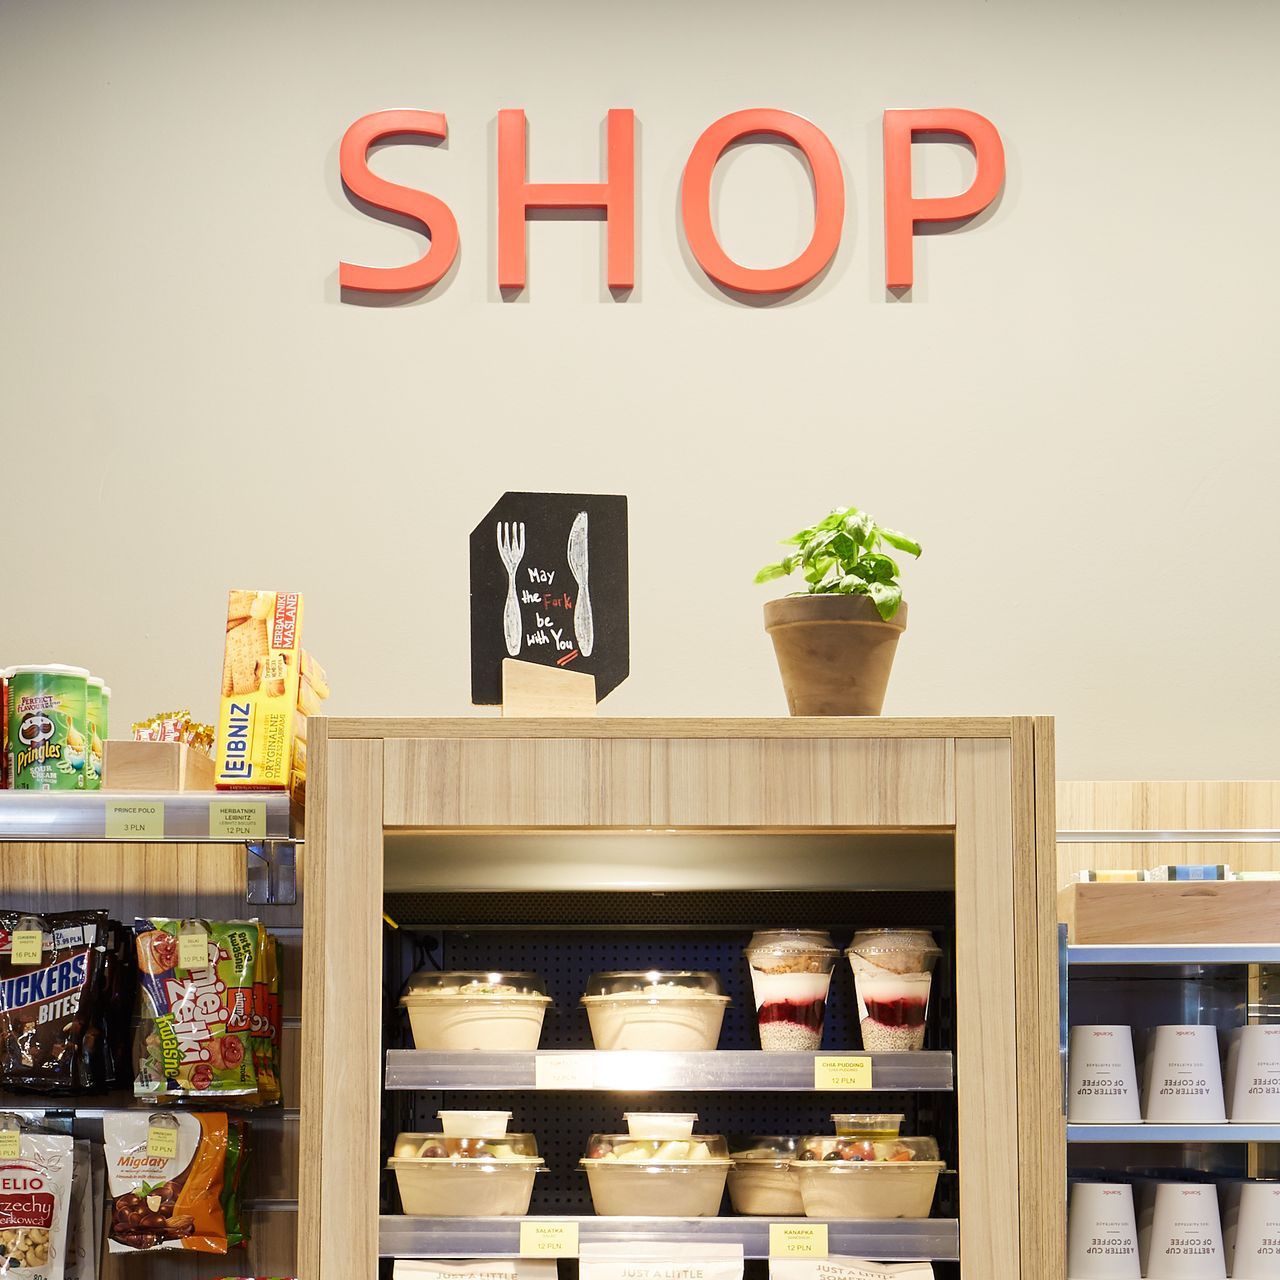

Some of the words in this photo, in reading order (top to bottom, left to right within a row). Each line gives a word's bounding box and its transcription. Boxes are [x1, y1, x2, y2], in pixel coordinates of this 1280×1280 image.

[339, 107, 1006, 294] SHOP
[528, 568, 555, 585] May
[521, 590, 542, 604] the
[543, 593, 572, 610] Fork
[274, 593, 287, 648] HERBATNIKI
[536, 613, 554, 627] be
[527, 630, 549, 646] with
[551, 629, 573, 650] You
[220, 703, 253, 779] LEIBNIZ
[265, 714, 279, 778] ORYGINALNE
[17, 743, 61, 774] Pringles
[239, 932, 252, 962] extra
[38, 993, 80, 1025] BITES
[622, 1269, 649, 1278] JUST
[654, 1270, 661, 1278] A
[665, 1270, 703, 1279] LITTLE
